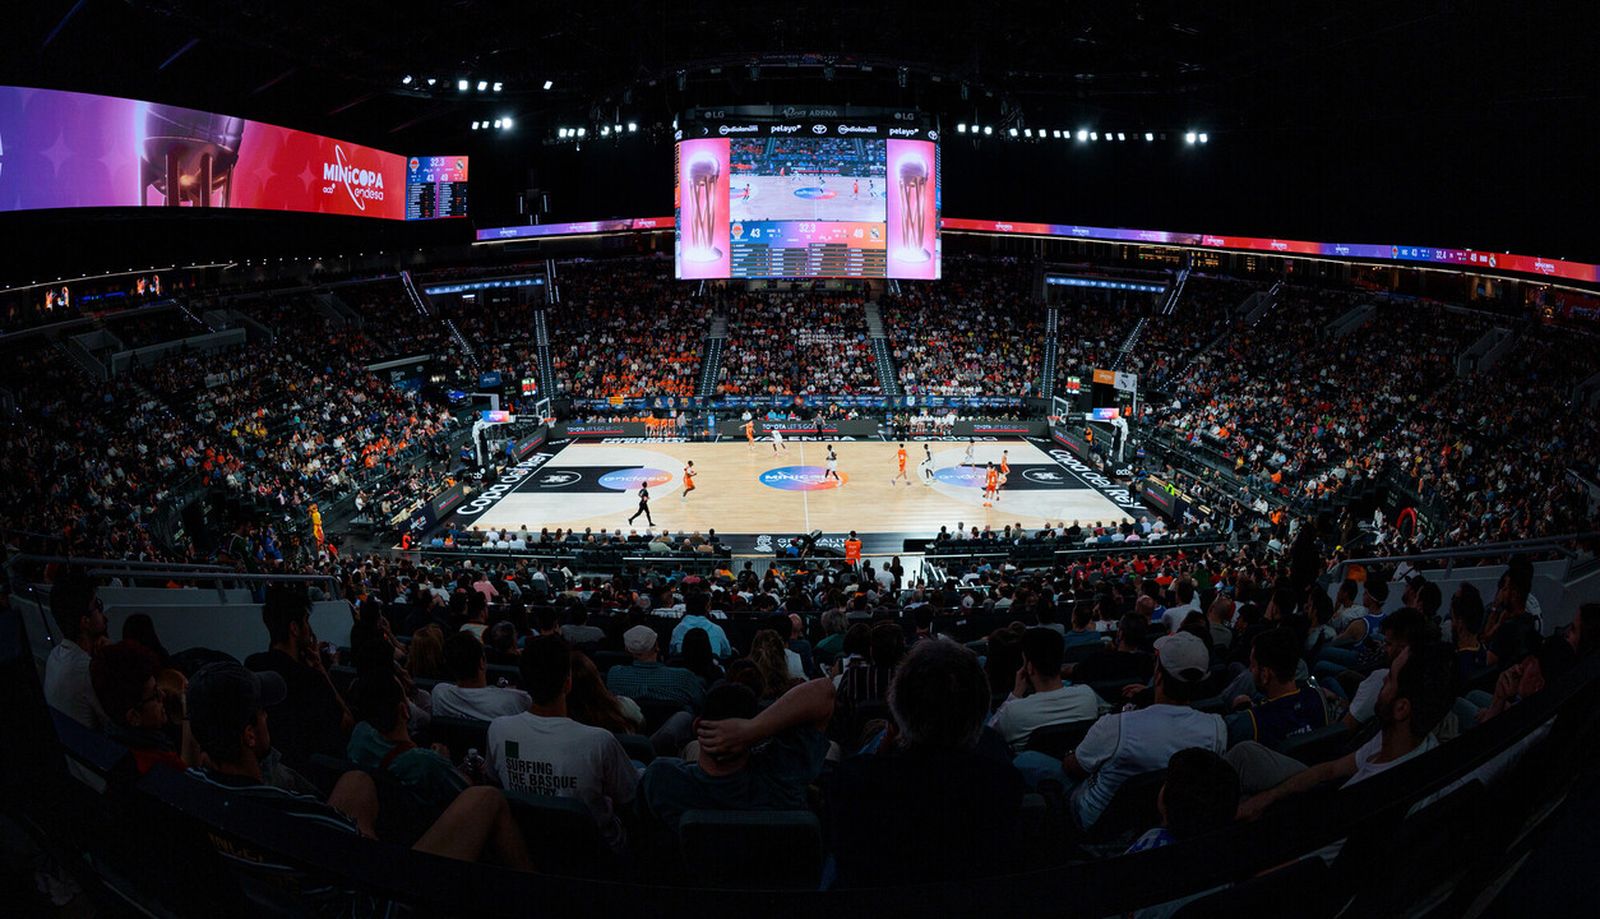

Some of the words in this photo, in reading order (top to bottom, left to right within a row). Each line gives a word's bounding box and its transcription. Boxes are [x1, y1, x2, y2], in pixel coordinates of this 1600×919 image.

[713, 111, 725, 119] LG
[809, 110, 839, 118] ARENA
[902, 112, 915, 120] LG
[770, 125, 798, 134] pelayo
[889, 128, 915, 137] pelayo
[430, 157, 445, 167] 32.3
[354, 187, 384, 201] endesa
[799, 223, 817, 233] 32.3
[750, 228, 761, 239] 43
[1116, 468, 1130, 476] acb
[1049, 449, 1092, 471] Copa
[1082, 471, 1120, 488] del
[1105, 489, 1148, 510] Rey
[457, 484, 512, 515] Copa
[505, 758, 554, 775] SURFING
[507, 771, 527, 785] THE
[529, 774, 578, 790] BASQUE
